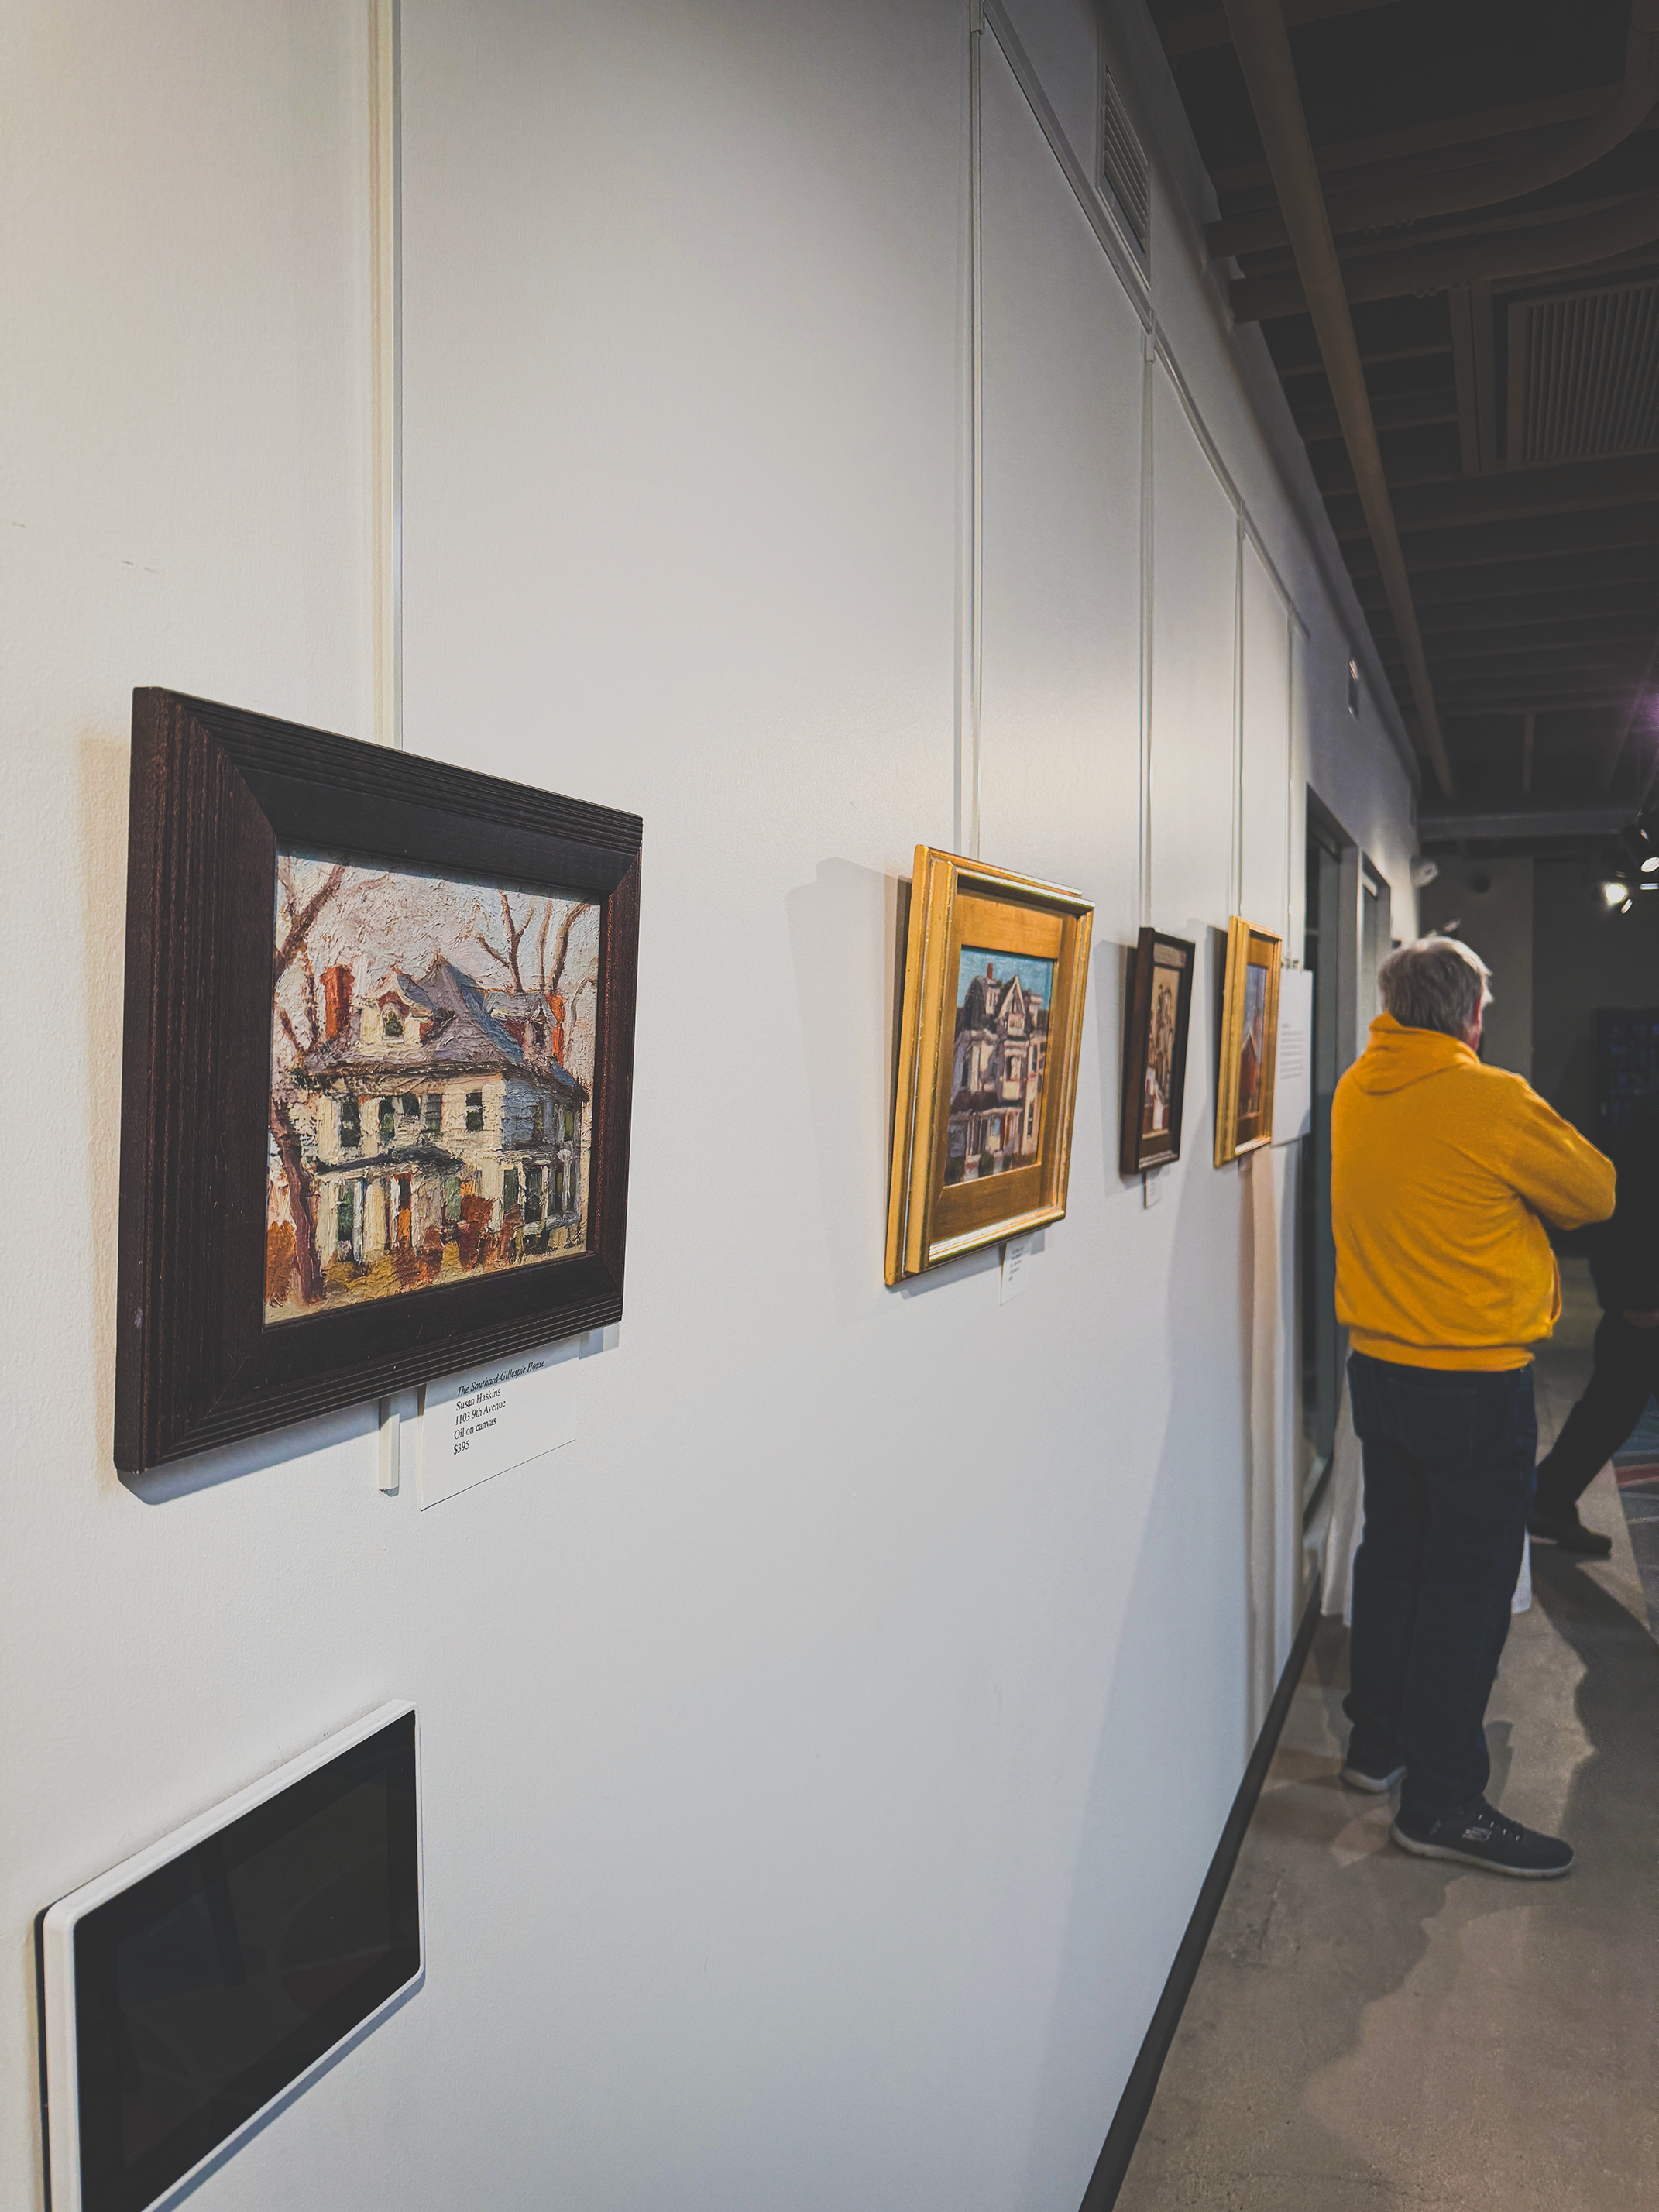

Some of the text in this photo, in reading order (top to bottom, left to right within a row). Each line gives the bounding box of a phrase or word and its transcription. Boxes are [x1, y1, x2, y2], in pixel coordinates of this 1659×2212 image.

[457, 1360, 544, 1397] The Southard-Gillespie House
[455, 1389, 501, 1411] Susan Haskins
[455, 1400, 506, 1425] 1103 9th Avenue
[454, 1417, 496, 1440] Oil on canvas
[453, 1440, 470, 1455] $395
